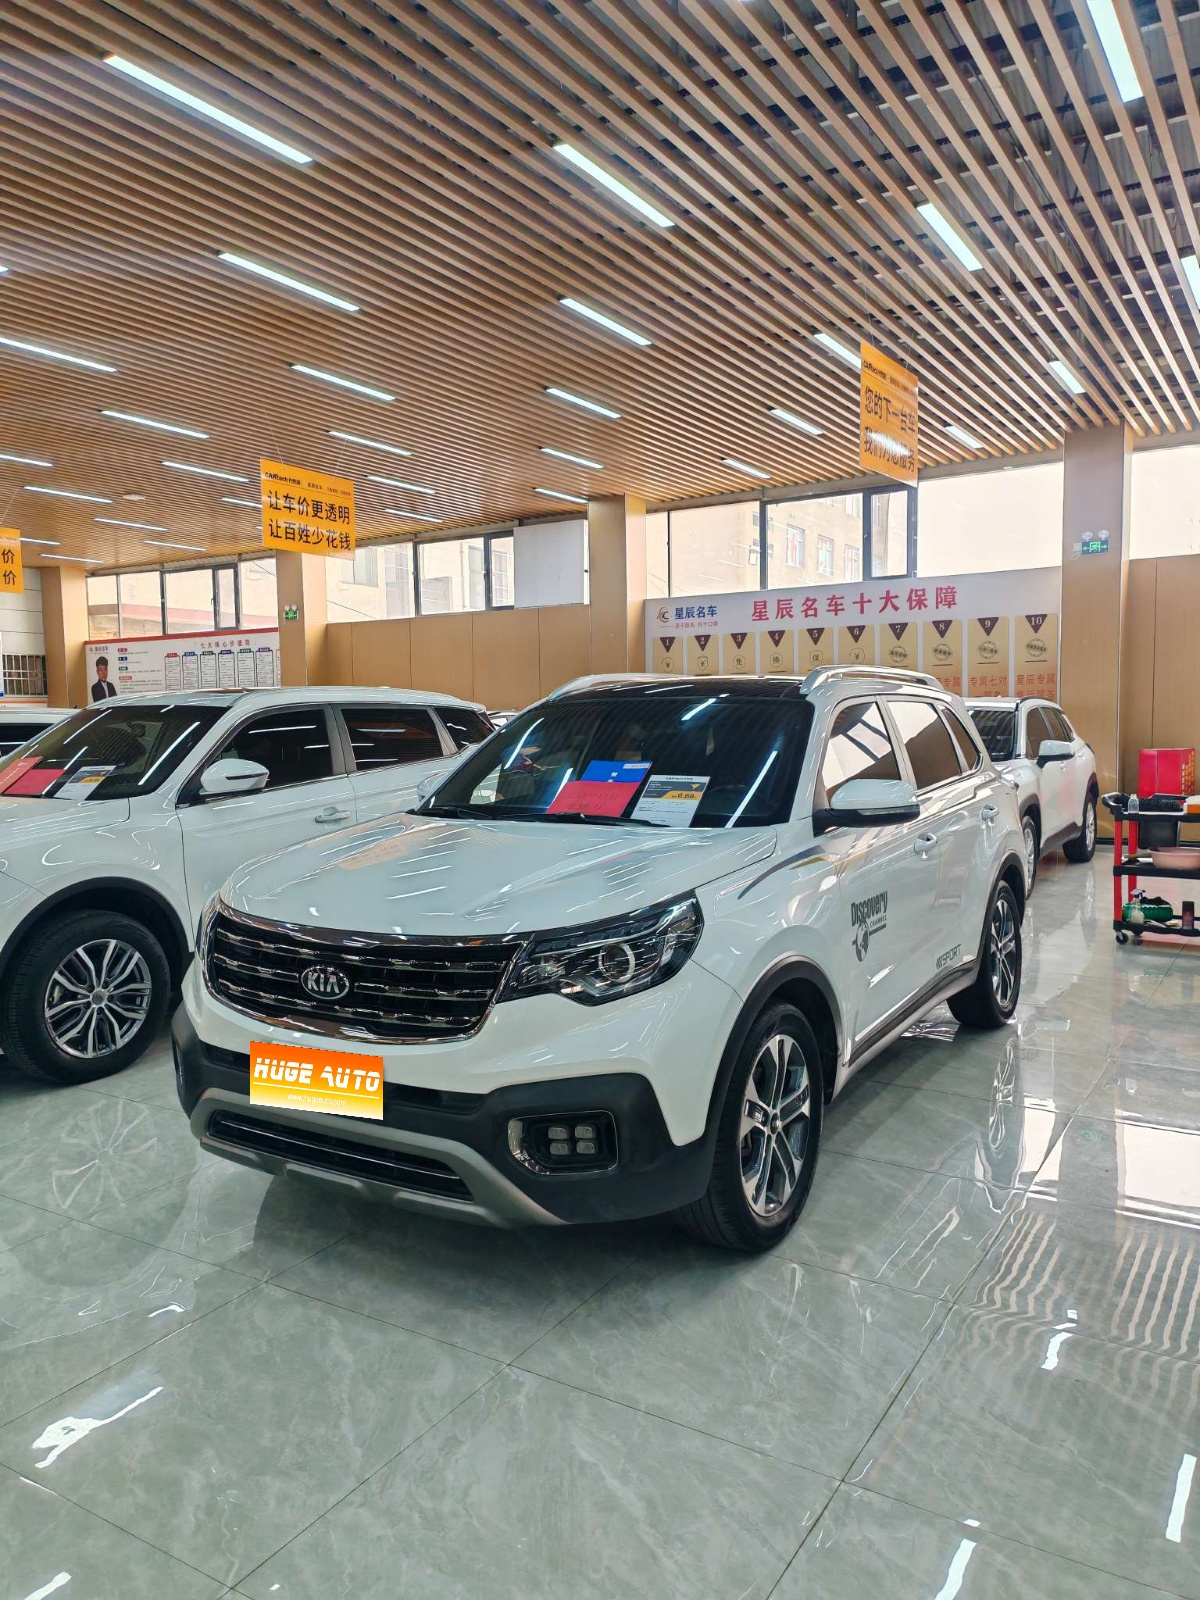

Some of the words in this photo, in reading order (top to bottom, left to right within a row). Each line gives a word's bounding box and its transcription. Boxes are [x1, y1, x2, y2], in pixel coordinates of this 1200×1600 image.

[864, 385, 916, 435] 您的下一台车
[267, 490, 350, 525] 让车价更透明
[268, 519, 351, 551] 让百姓少花钱
[1, 549, 15, 564] 价
[3, 570, 17, 586] 价
[751, 586, 957, 621] 星辰名车十大保障
[675, 605, 718, 620] 星辰名车
[939, 622, 945, 630] 8
[984, 619, 991, 628] 9
[1030, 617, 1042, 626] 10
[812, 630, 818, 638] 5
[853, 628, 859, 636] 6
[895, 625, 901, 633] 7
[700, 636, 705, 645] 2
[736, 634, 742, 642] 3
[773, 632, 779, 641] 4
[1016, 673, 1056, 686] 星辰专属
[851, 890, 888, 927] Discovery
[869, 914, 887, 928] CHANNEL
[307, 971, 340, 994] KIA
